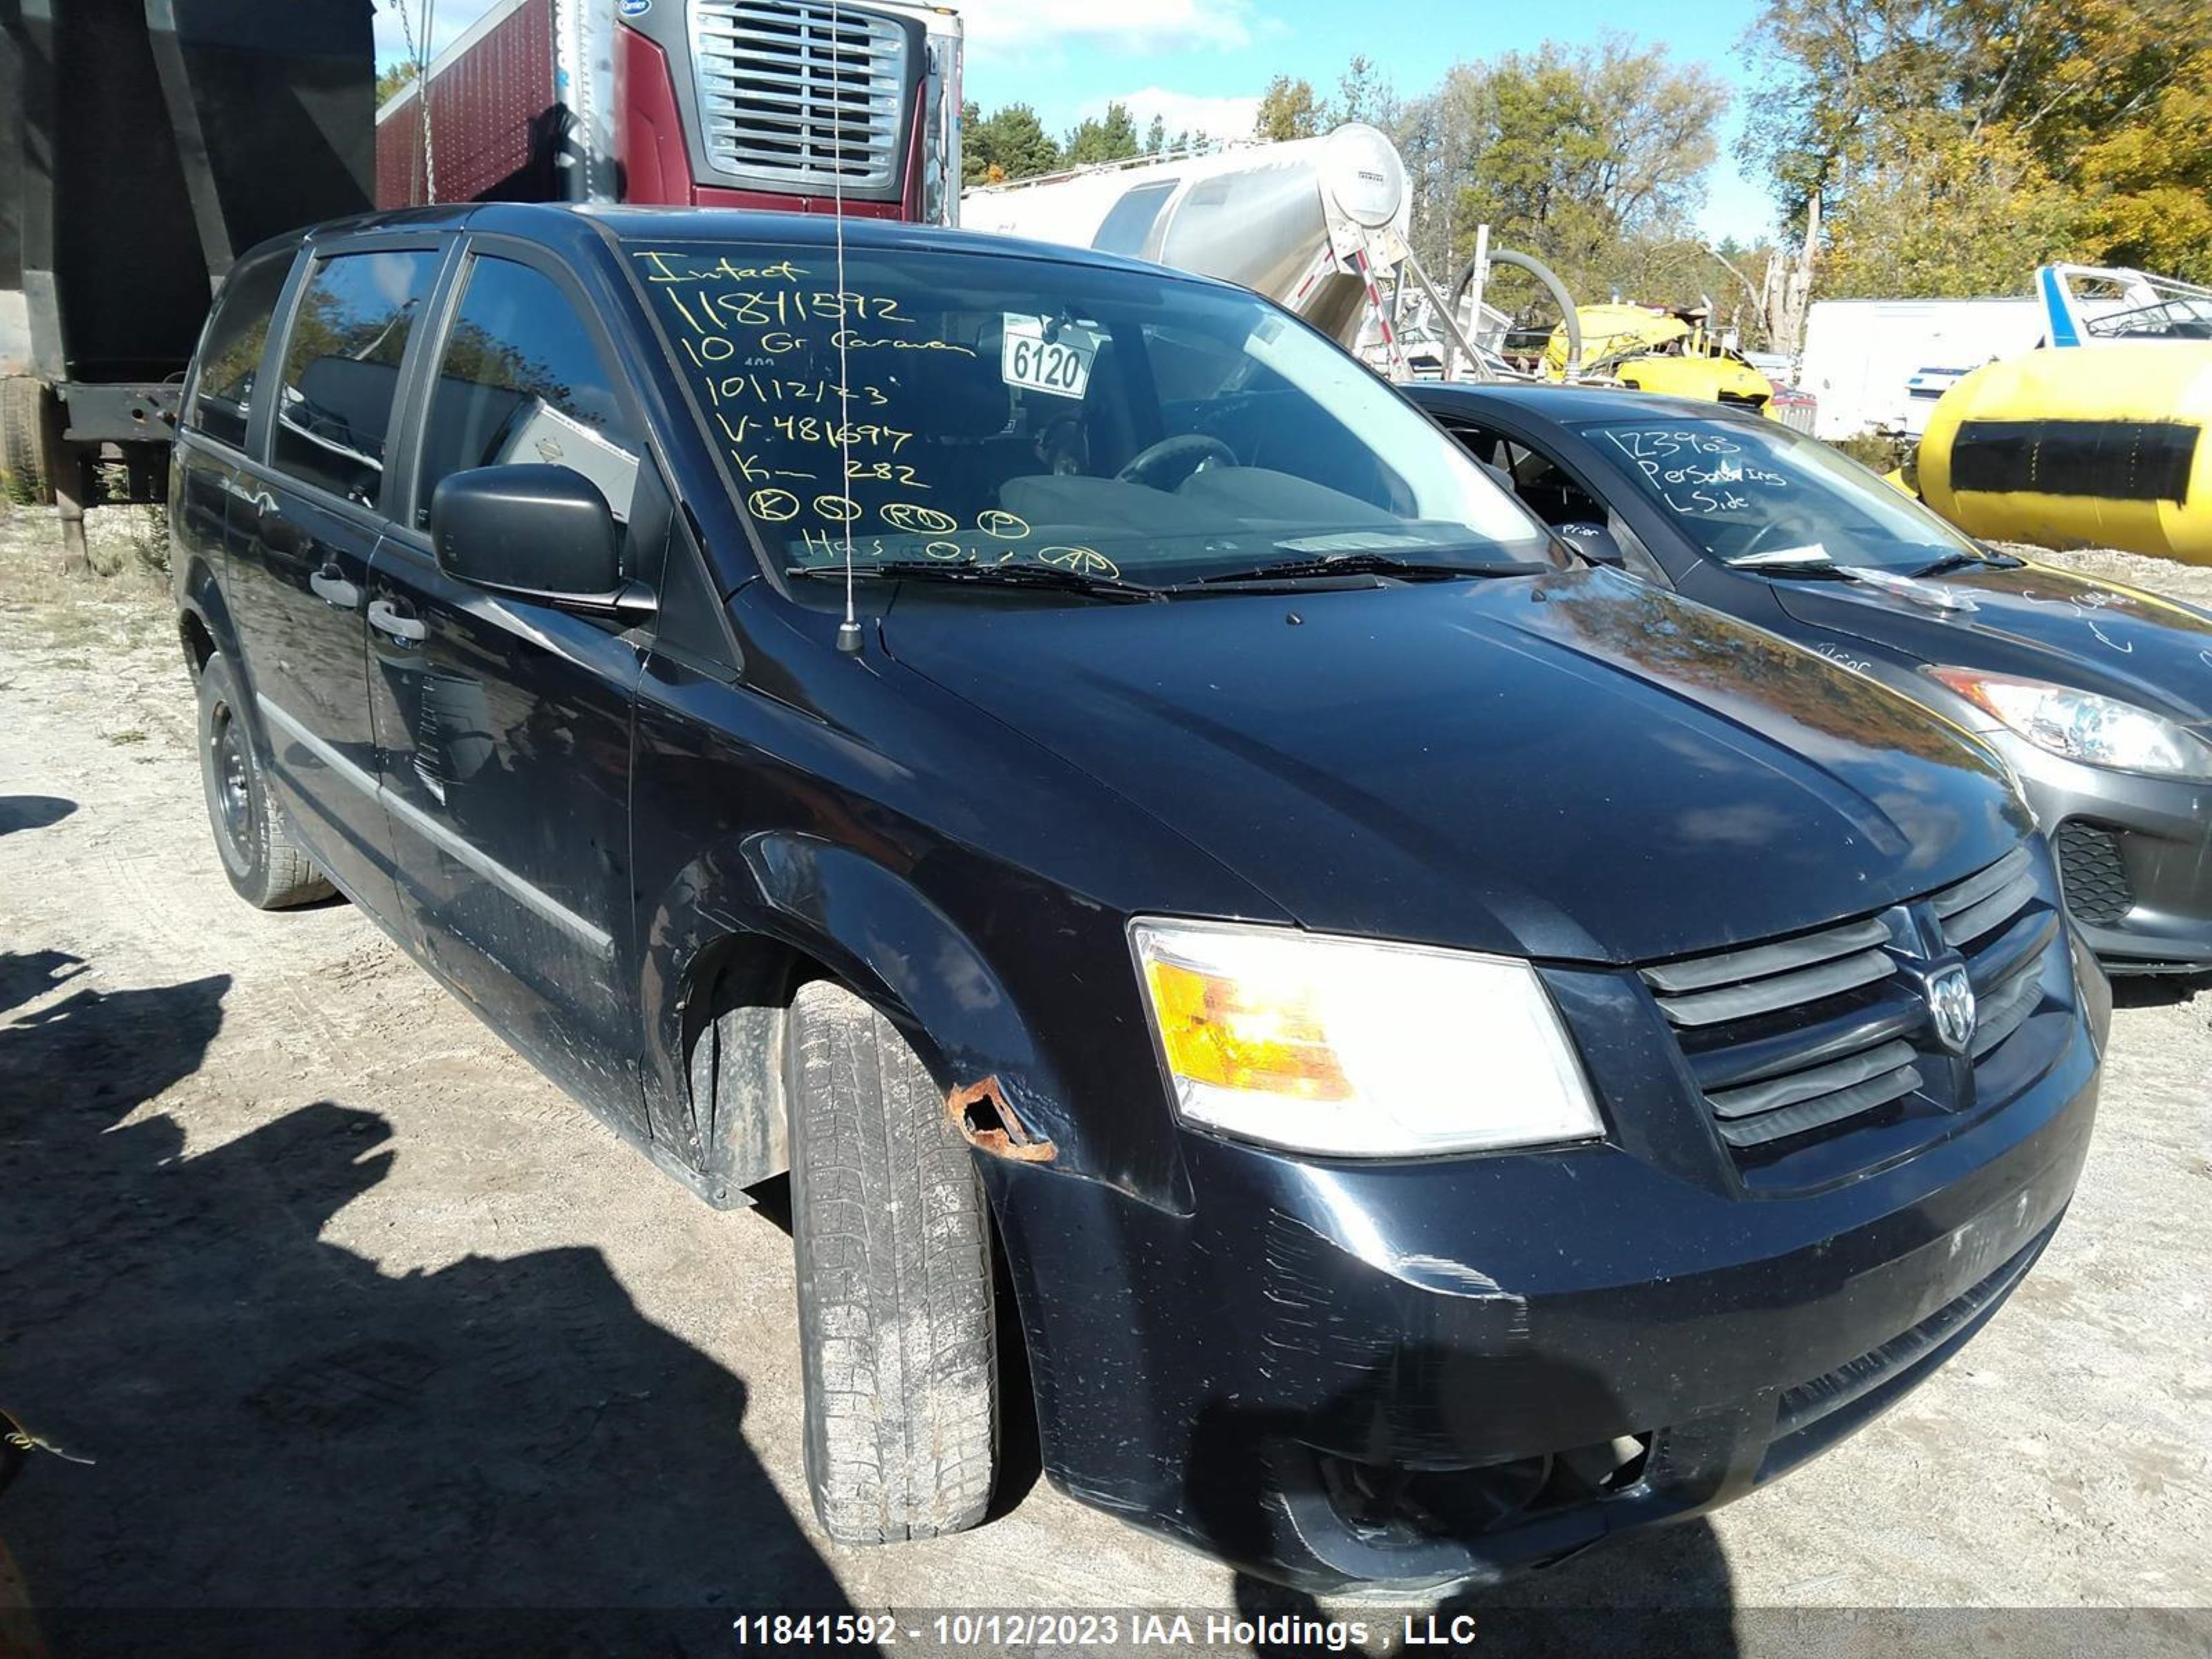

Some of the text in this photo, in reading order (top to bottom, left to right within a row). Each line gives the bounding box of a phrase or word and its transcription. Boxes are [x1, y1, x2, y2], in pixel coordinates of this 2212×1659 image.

[632, 250, 812, 283] Intact
[665, 286, 917, 335] 11841592
[681, 336, 734, 368] 10
[760, 332, 808, 353] Gr
[1014, 340, 1080, 388] 6120
[847, 460, 932, 489] 282
[1691, 491, 1749, 513] Side
